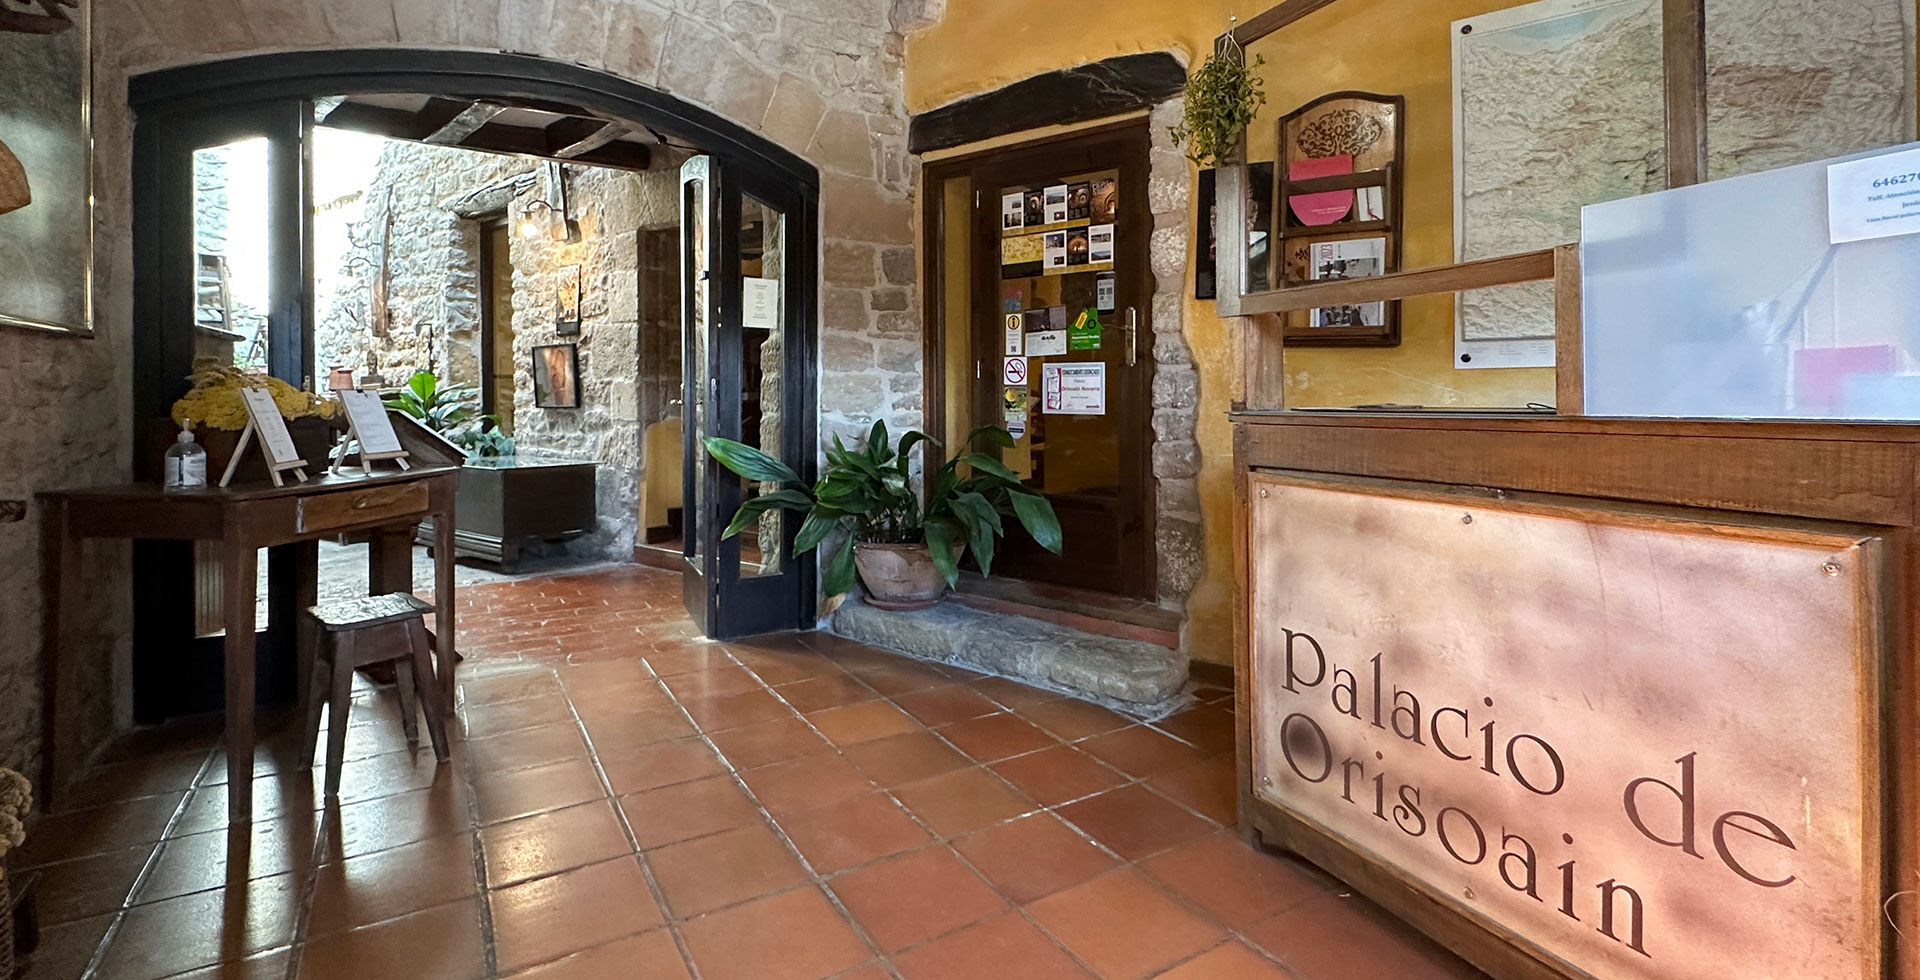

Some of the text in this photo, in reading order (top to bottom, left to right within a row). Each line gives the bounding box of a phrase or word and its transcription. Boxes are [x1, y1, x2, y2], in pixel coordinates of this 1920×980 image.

[1279, 712, 1652, 959] Orisoain
[1281, 627, 1798, 888] Palacio de
